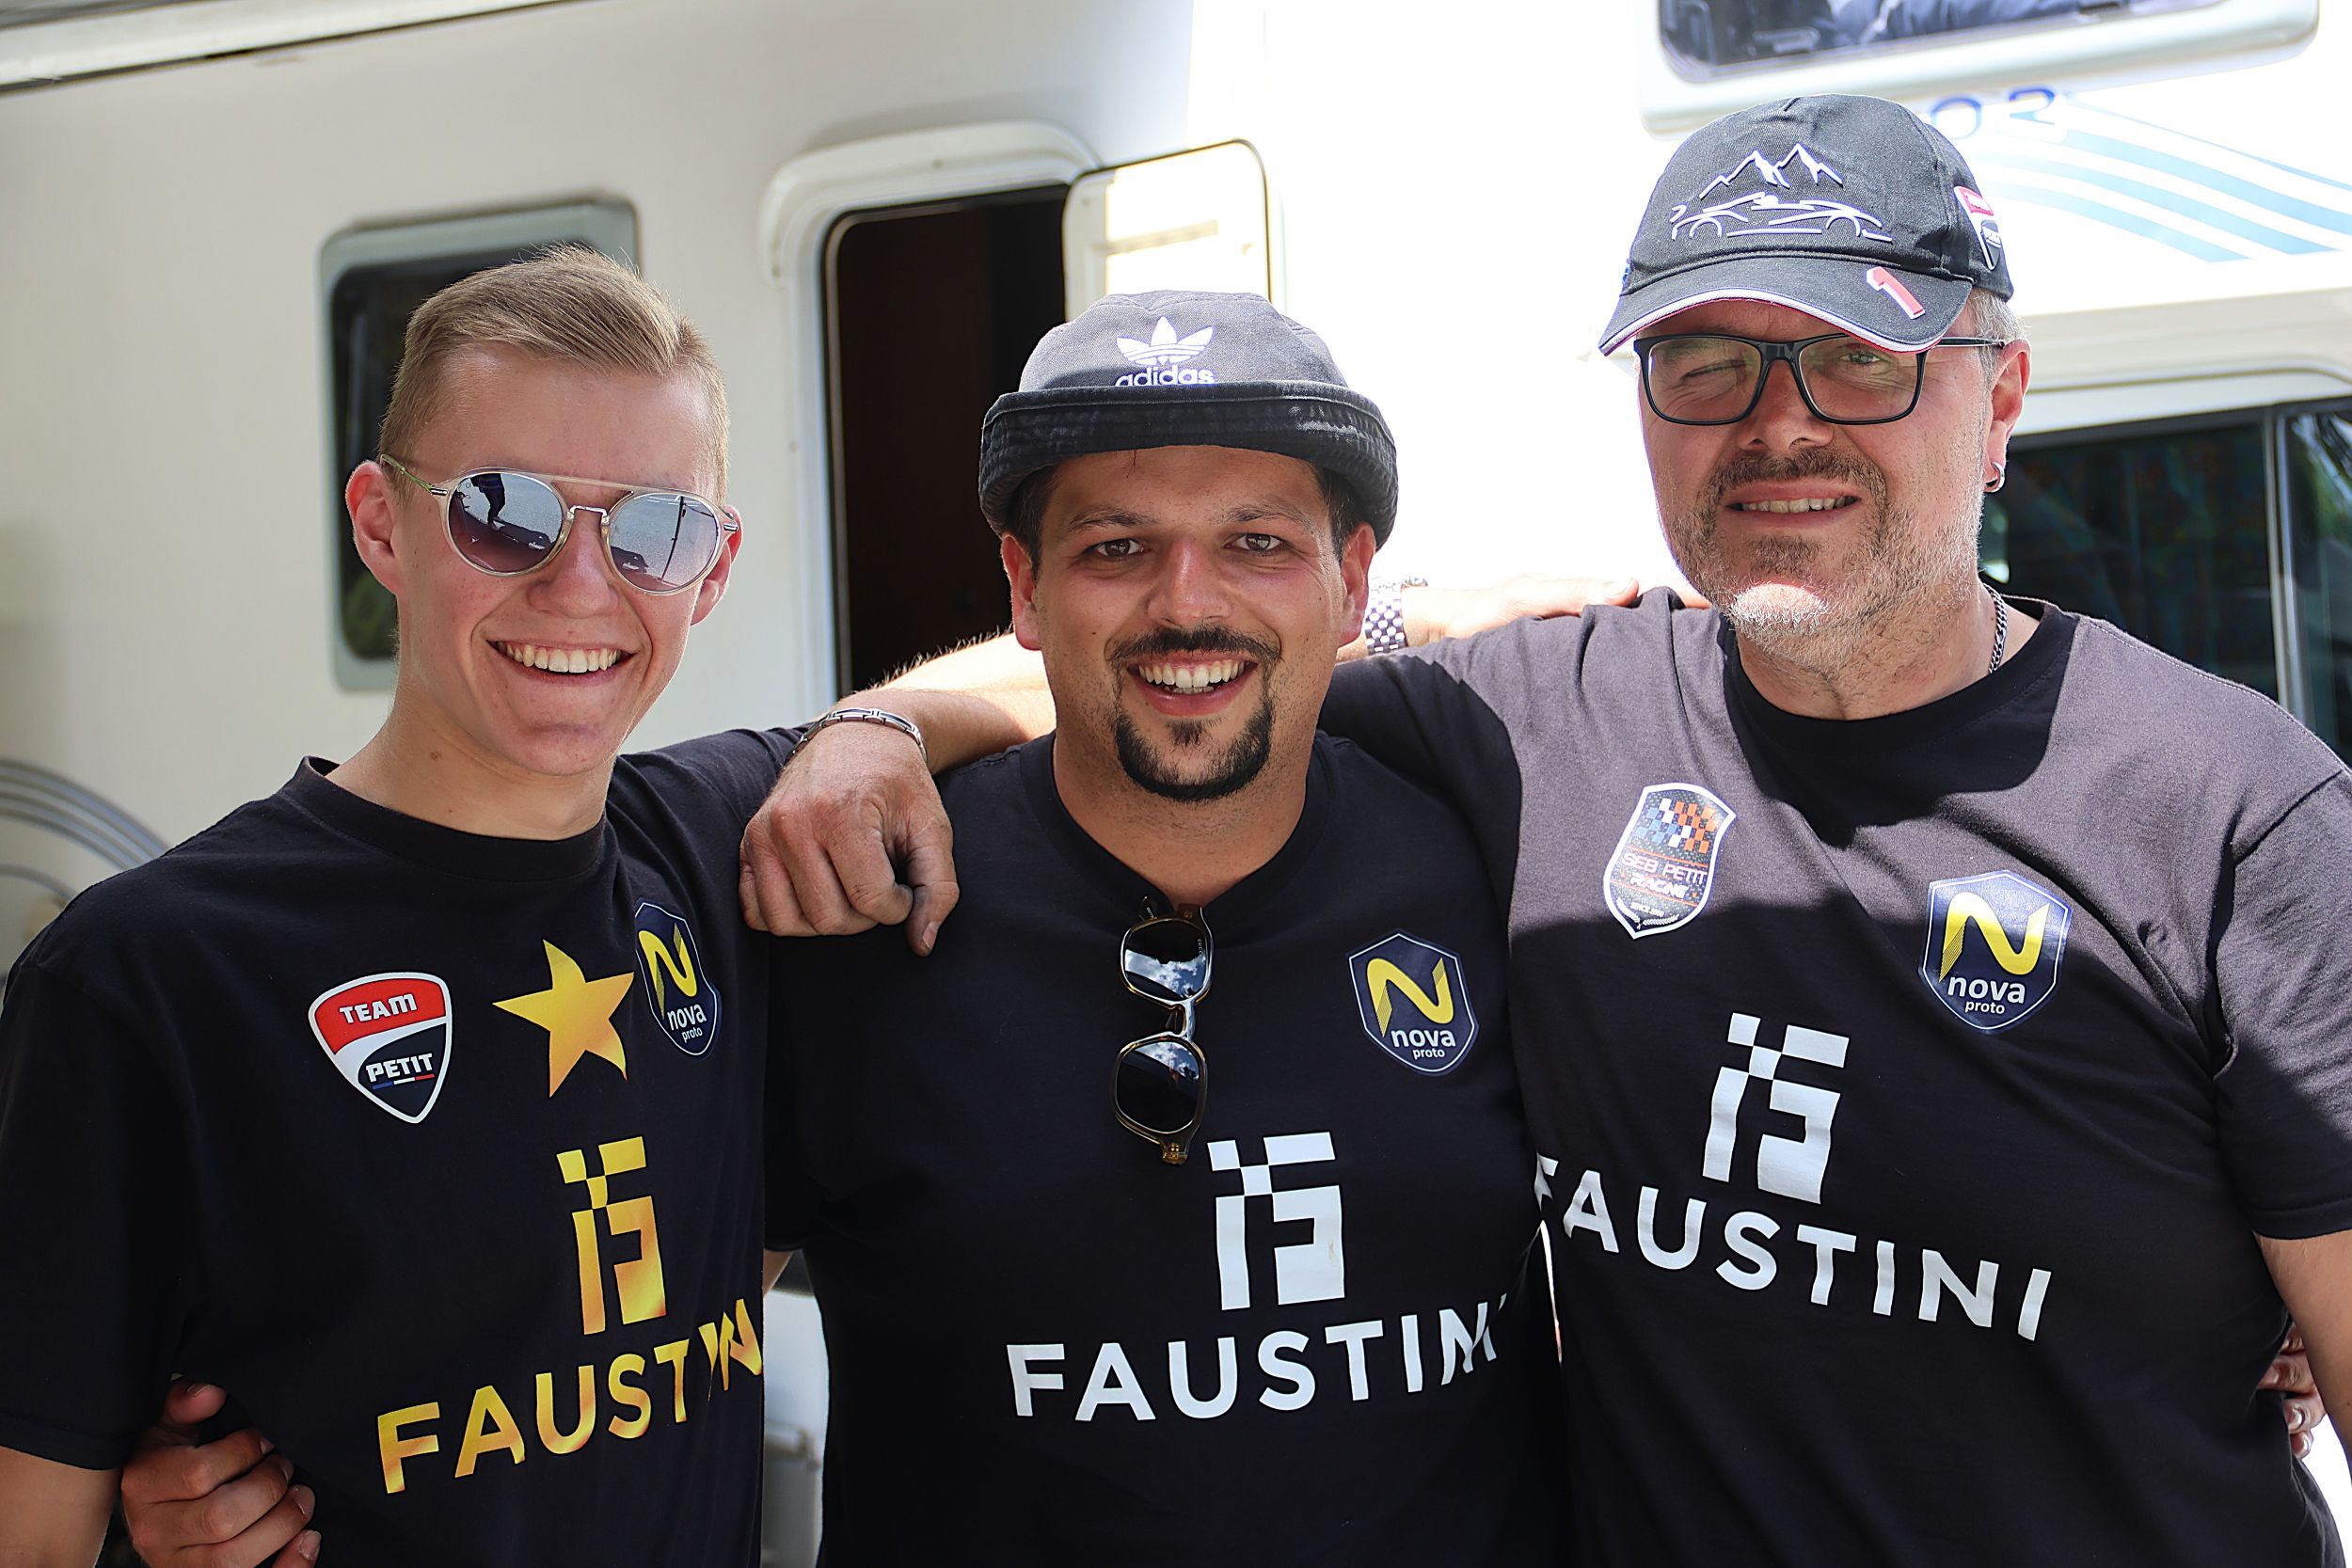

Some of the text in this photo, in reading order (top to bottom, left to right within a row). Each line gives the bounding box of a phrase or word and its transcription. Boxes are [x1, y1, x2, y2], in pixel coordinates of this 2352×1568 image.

[1114, 364, 1216, 388] adidas
[1621, 852, 1708, 885] SEB PETIT
[1947, 976, 2026, 1004] nova
[339, 993, 418, 1023] TEAM
[667, 1004, 707, 1031] nova
[1964, 1000, 2006, 1015] proto
[681, 1026, 703, 1043] proto
[1391, 1029, 1456, 1048] nova
[1413, 1047, 1446, 1061] proto
[365, 1053, 433, 1083] PETIT
[1534, 1151, 2052, 1341] FAUSTINI
[1007, 1292, 1507, 1421] FAUSTIN
